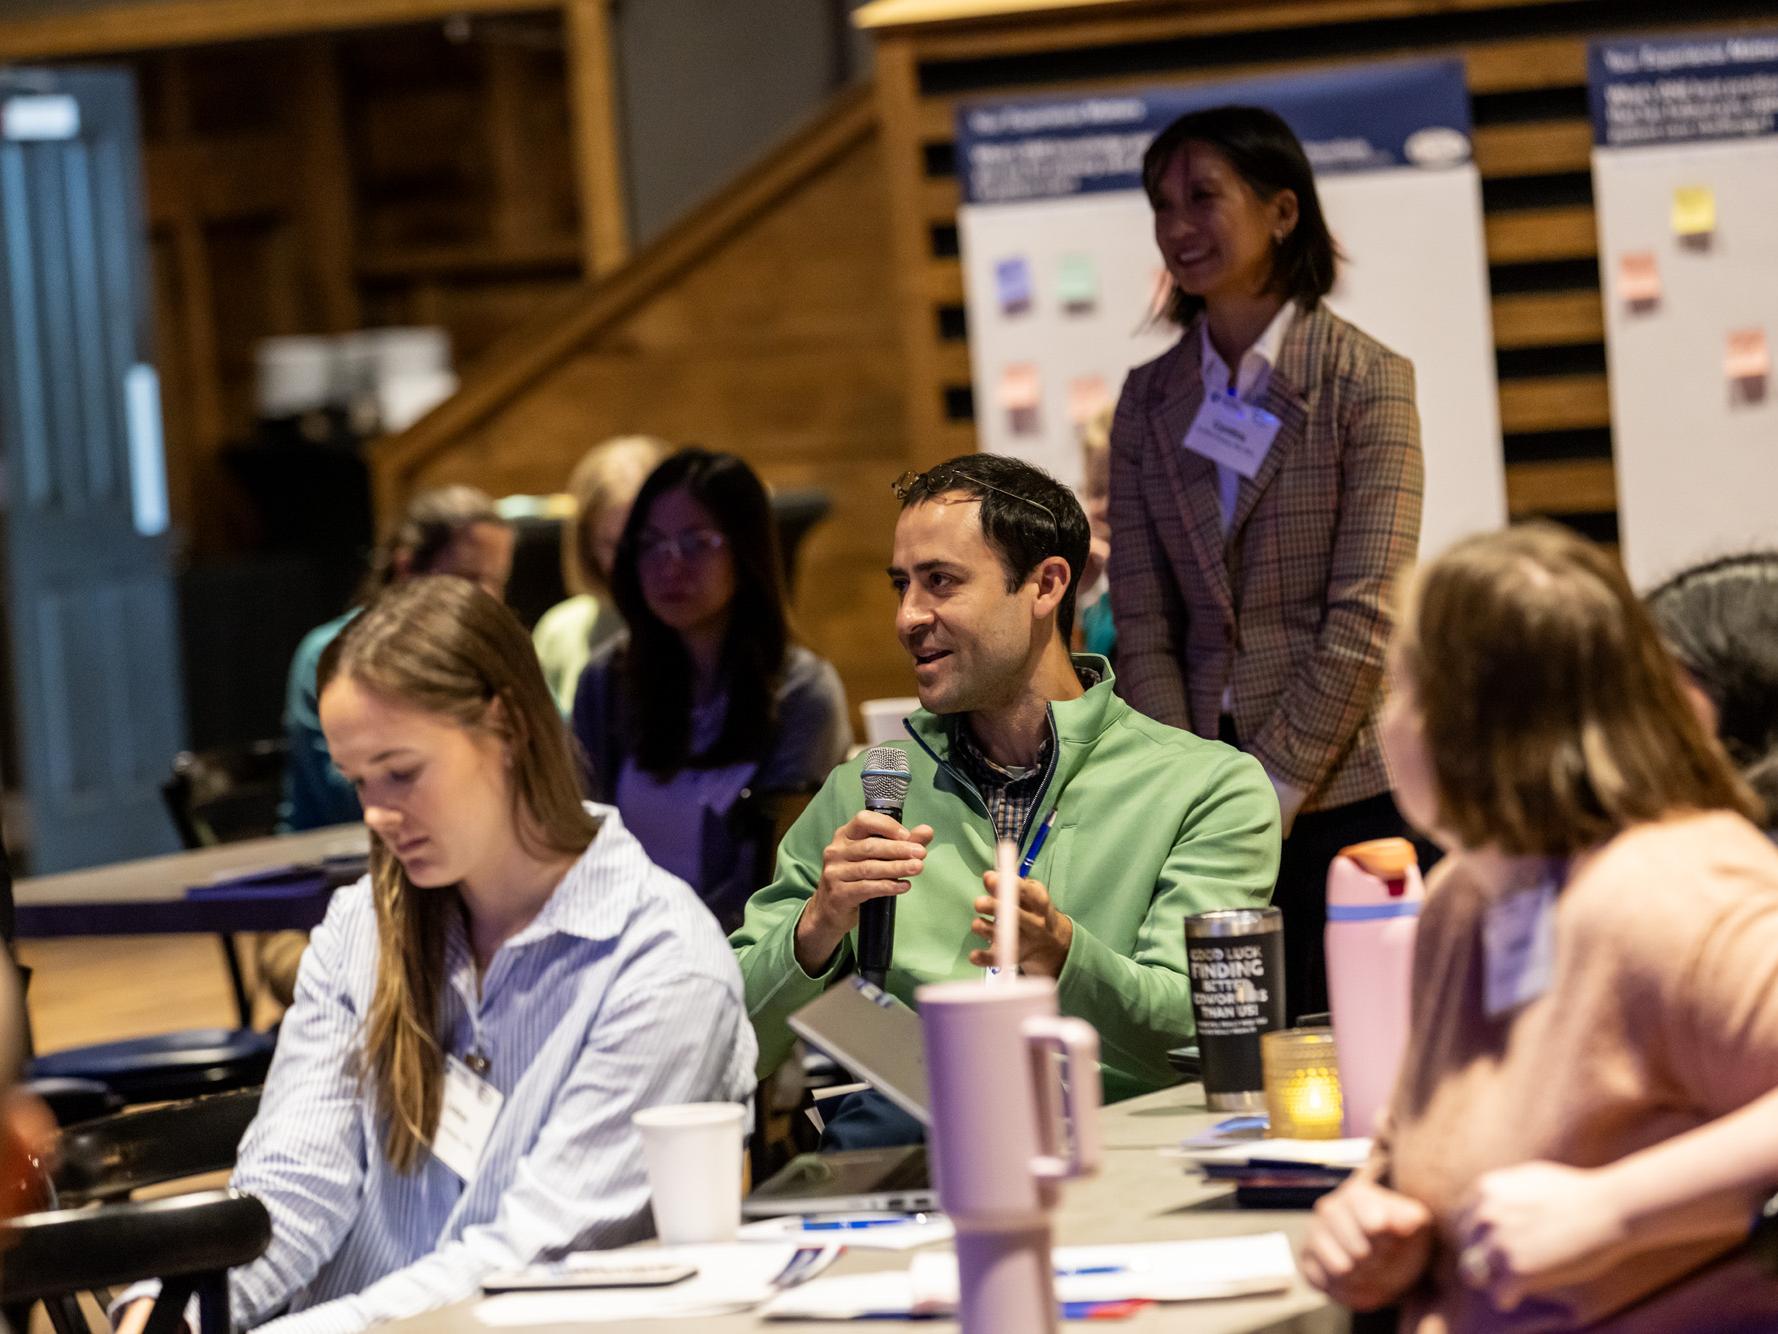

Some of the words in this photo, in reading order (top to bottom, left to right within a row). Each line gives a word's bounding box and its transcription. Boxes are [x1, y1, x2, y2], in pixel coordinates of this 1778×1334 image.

[1190, 948, 1224, 961] GOOD
[1225, 946, 1263, 960] LUCK
[1191, 959, 1264, 978] FINDING
[1202, 978, 1253, 992] BETTE
[1200, 1005, 1235, 1019] THAN
